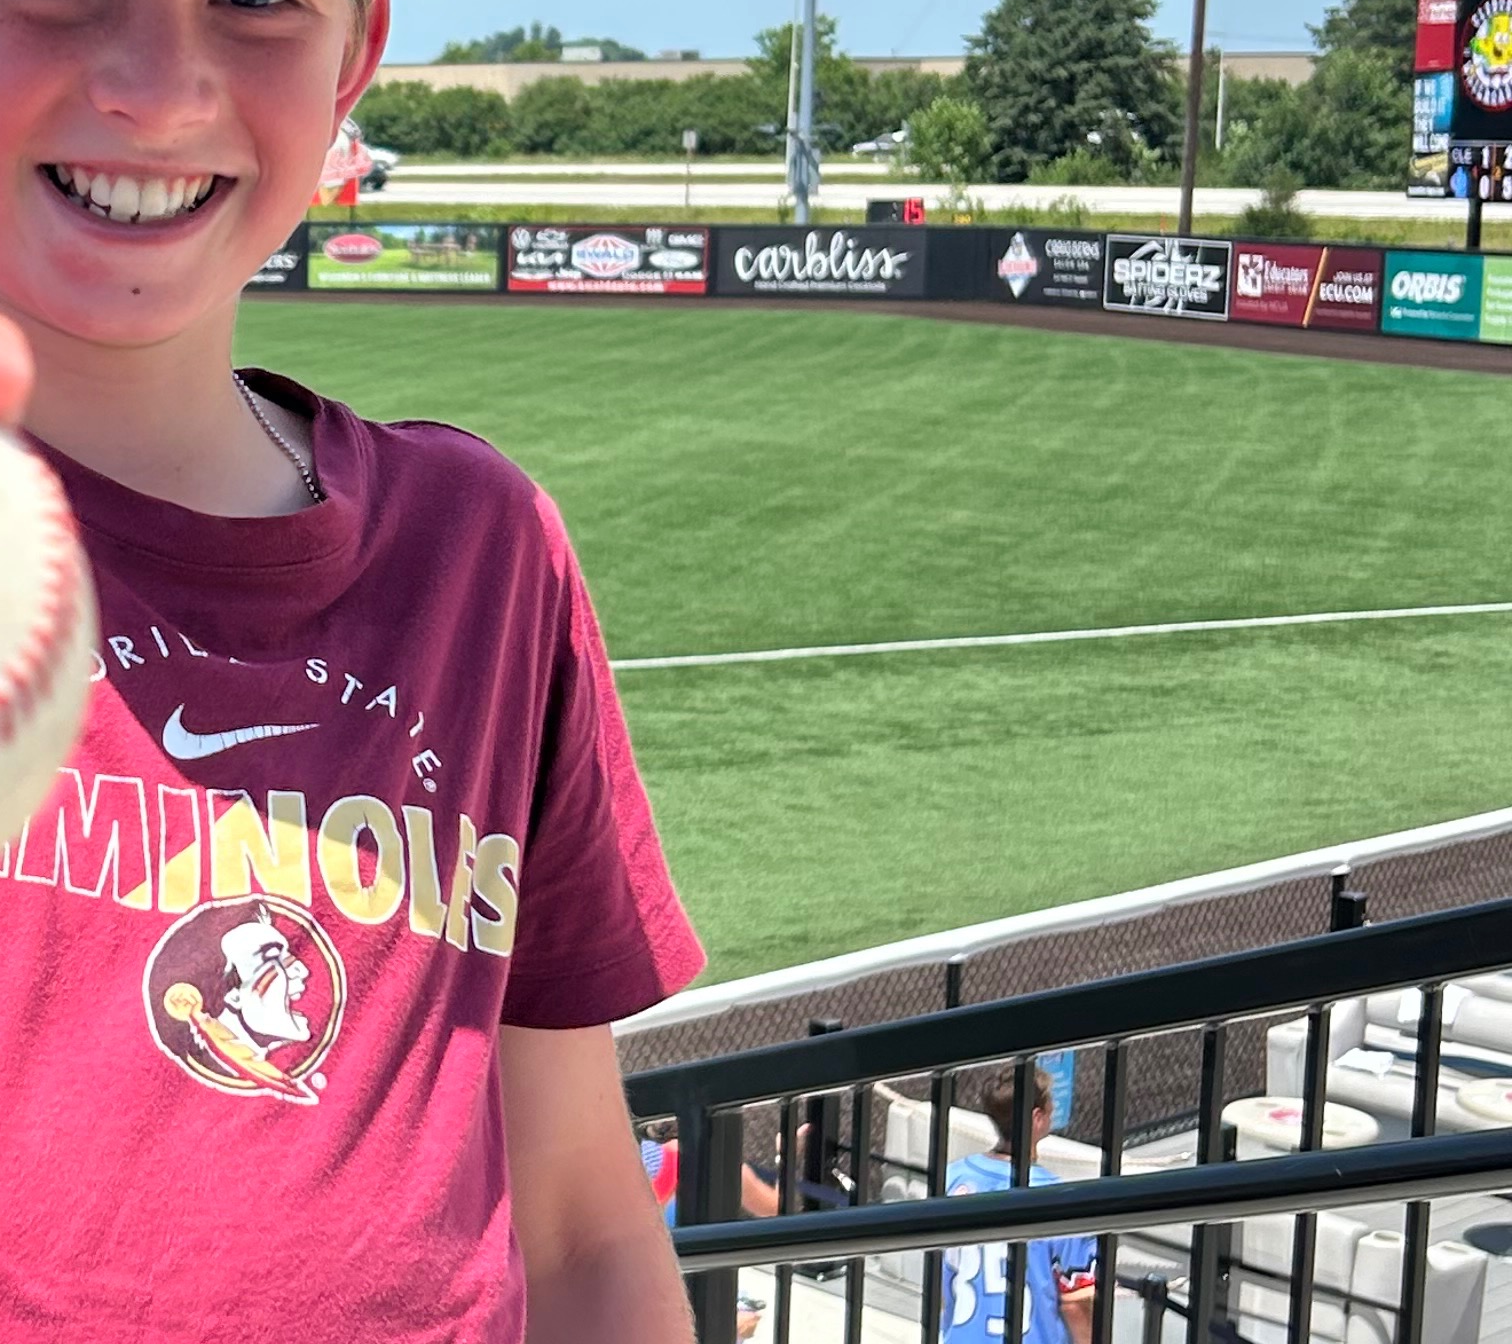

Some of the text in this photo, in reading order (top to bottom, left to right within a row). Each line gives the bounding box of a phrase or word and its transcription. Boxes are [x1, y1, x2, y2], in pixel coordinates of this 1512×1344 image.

[734, 231, 910, 282] carbliss
[1114, 257, 1221, 292] SPIDERZ
[1391, 270, 1462, 305] ORBIS
